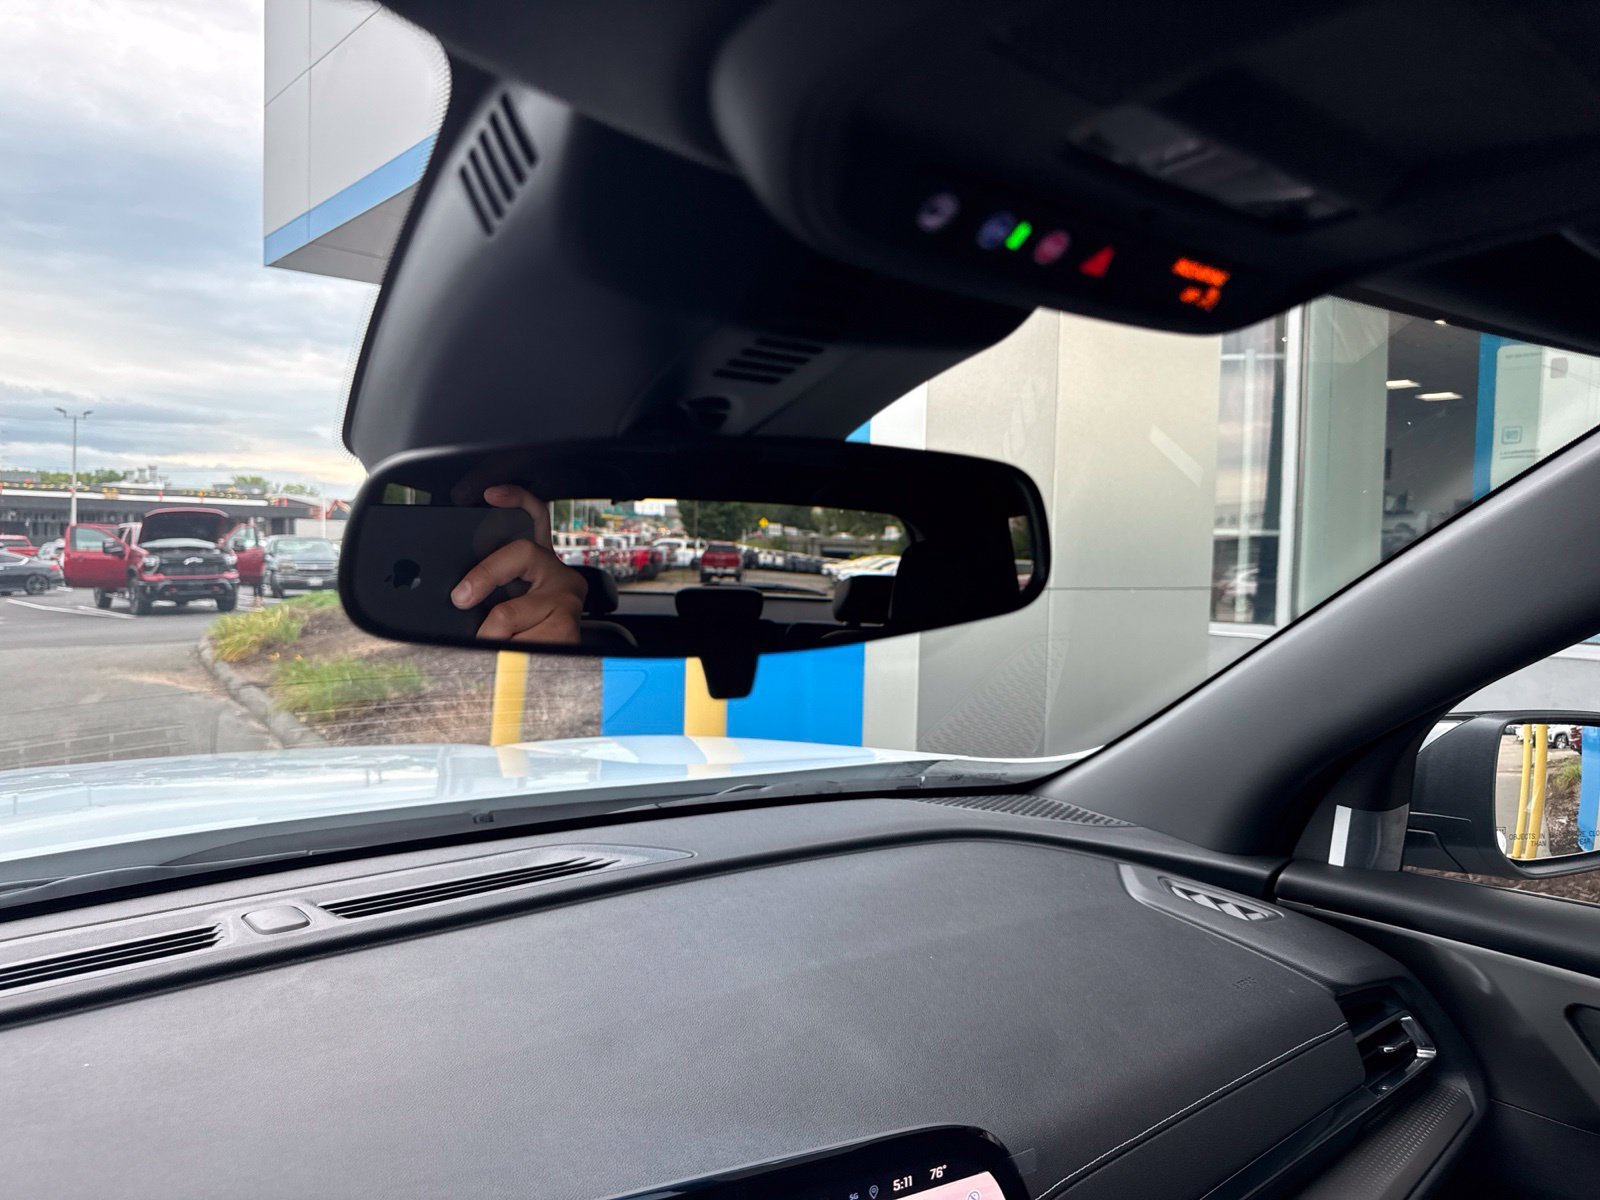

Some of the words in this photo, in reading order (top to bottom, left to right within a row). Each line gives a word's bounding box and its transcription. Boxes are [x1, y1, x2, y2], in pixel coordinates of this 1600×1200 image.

[1509, 833, 1536, 841] OBJECTS
[929, 1164, 948, 1180] 76°
[892, 1175, 913, 1191] 5:11
